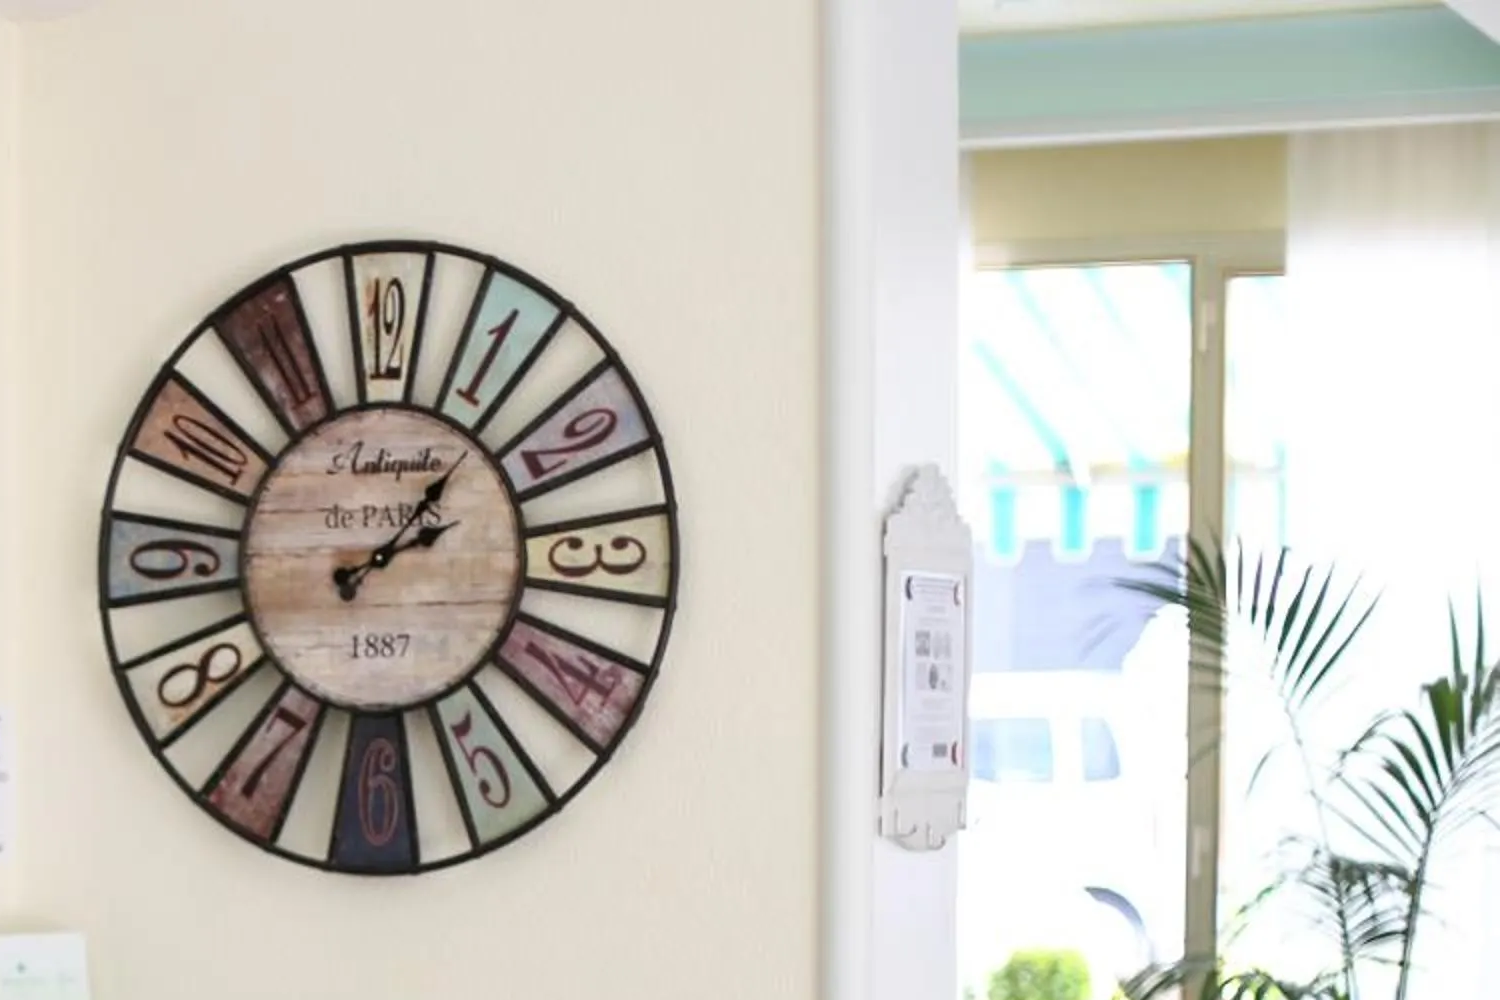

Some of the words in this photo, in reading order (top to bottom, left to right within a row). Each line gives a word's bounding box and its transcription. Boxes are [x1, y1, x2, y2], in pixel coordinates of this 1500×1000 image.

[257, 312, 318, 411] 11
[368, 278, 405, 380] 12
[456, 308, 520, 407] 1
[163, 414, 248, 486] 10
[520, 408, 618, 480] 2
[325, 503, 353, 529] de
[130, 540, 220, 580] 9
[548, 536, 647, 577] 3
[158, 643, 242, 708] 8
[350, 632, 411, 659] 1887
[525, 641, 622, 707] 4
[241, 706, 307, 800] 7
[451, 709, 511, 808] 5
[358, 738, 398, 846] 6
